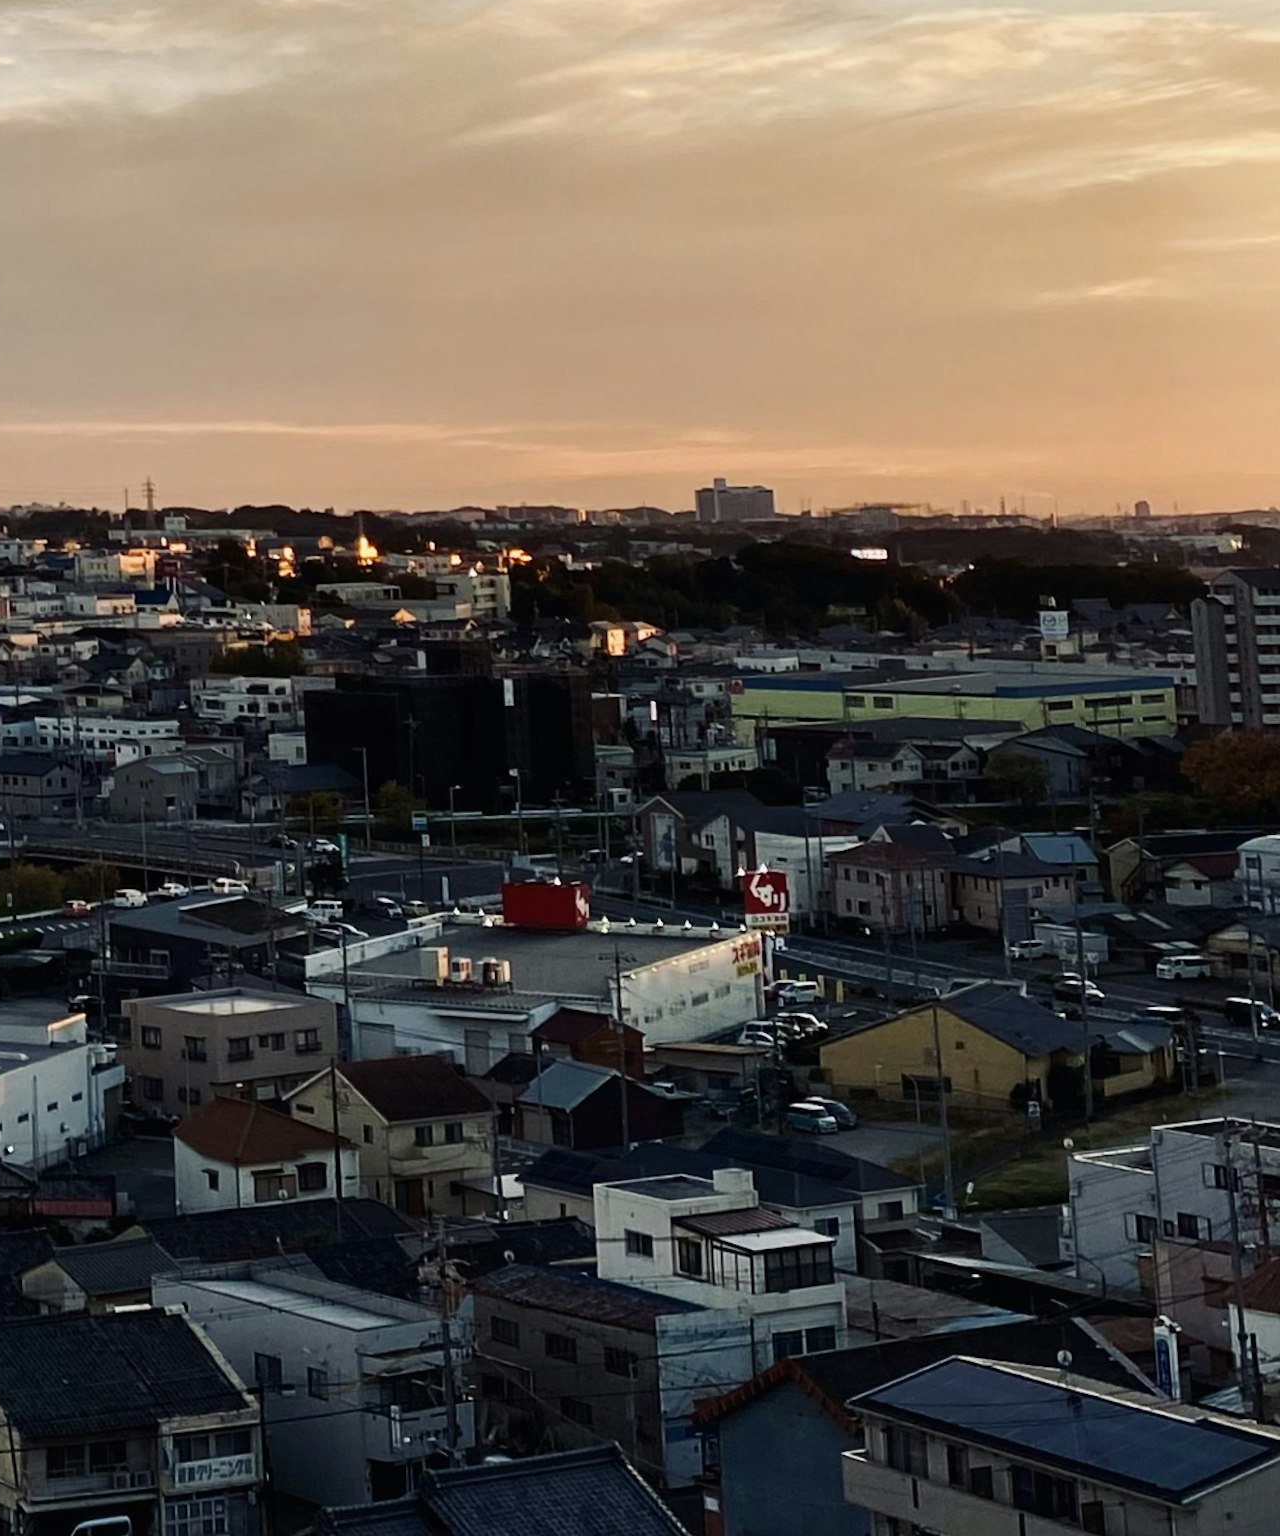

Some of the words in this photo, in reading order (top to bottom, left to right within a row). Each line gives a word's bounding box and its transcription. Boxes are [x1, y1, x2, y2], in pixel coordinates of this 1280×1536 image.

[178, 1459, 252, 1483] クリーニング
